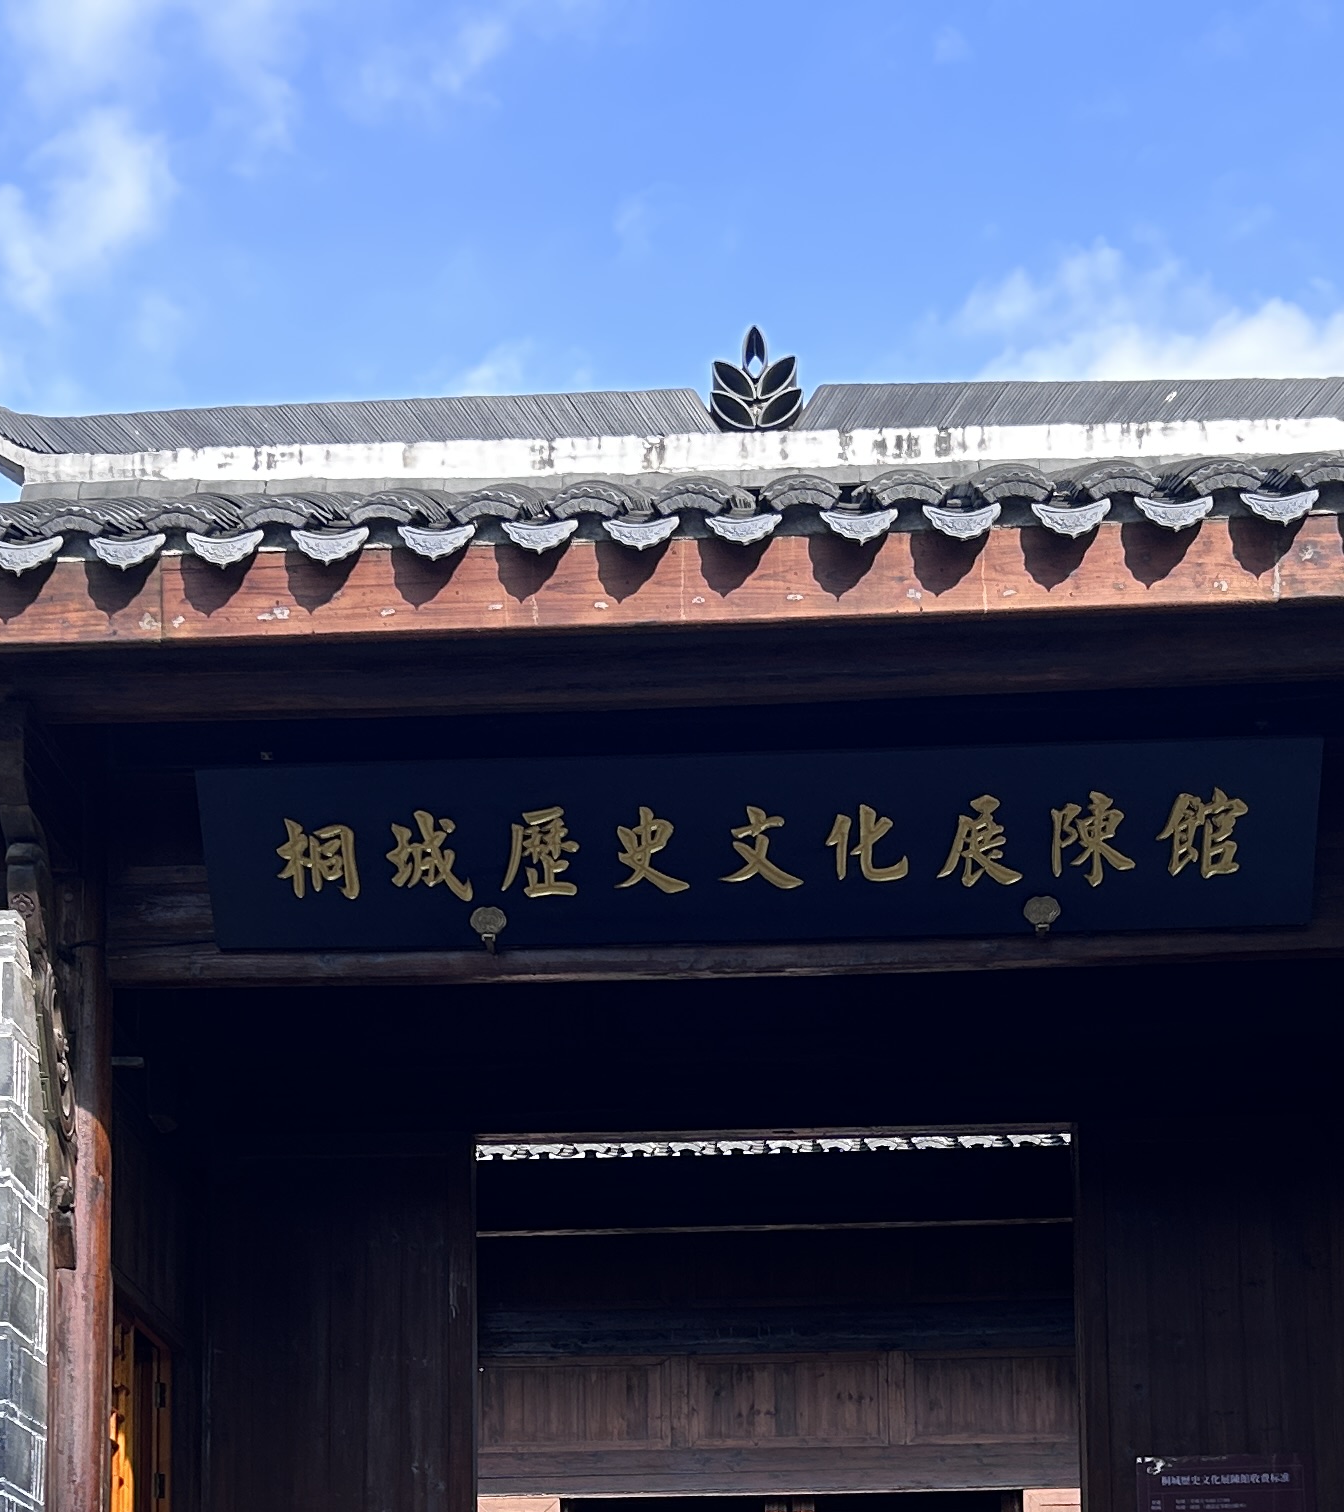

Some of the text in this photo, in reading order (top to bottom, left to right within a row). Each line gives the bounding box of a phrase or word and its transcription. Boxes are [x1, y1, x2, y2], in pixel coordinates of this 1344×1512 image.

[276, 787, 1249, 901] 桐城歷史文化展陳館
